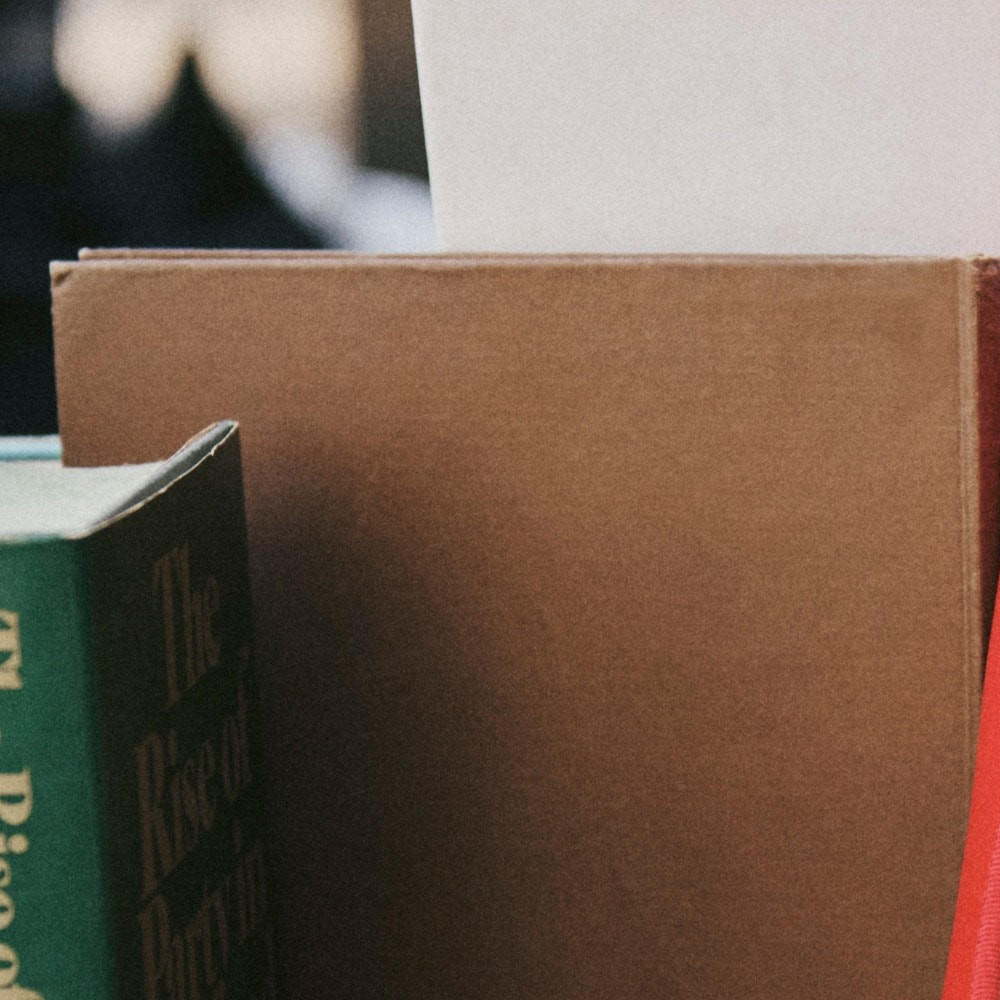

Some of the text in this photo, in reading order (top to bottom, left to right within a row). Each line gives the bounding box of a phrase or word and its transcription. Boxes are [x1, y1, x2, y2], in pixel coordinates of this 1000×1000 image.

[151, 541, 222, 711] The
[135, 642, 253, 905] Rise of
[233, 819, 269, 947] in
